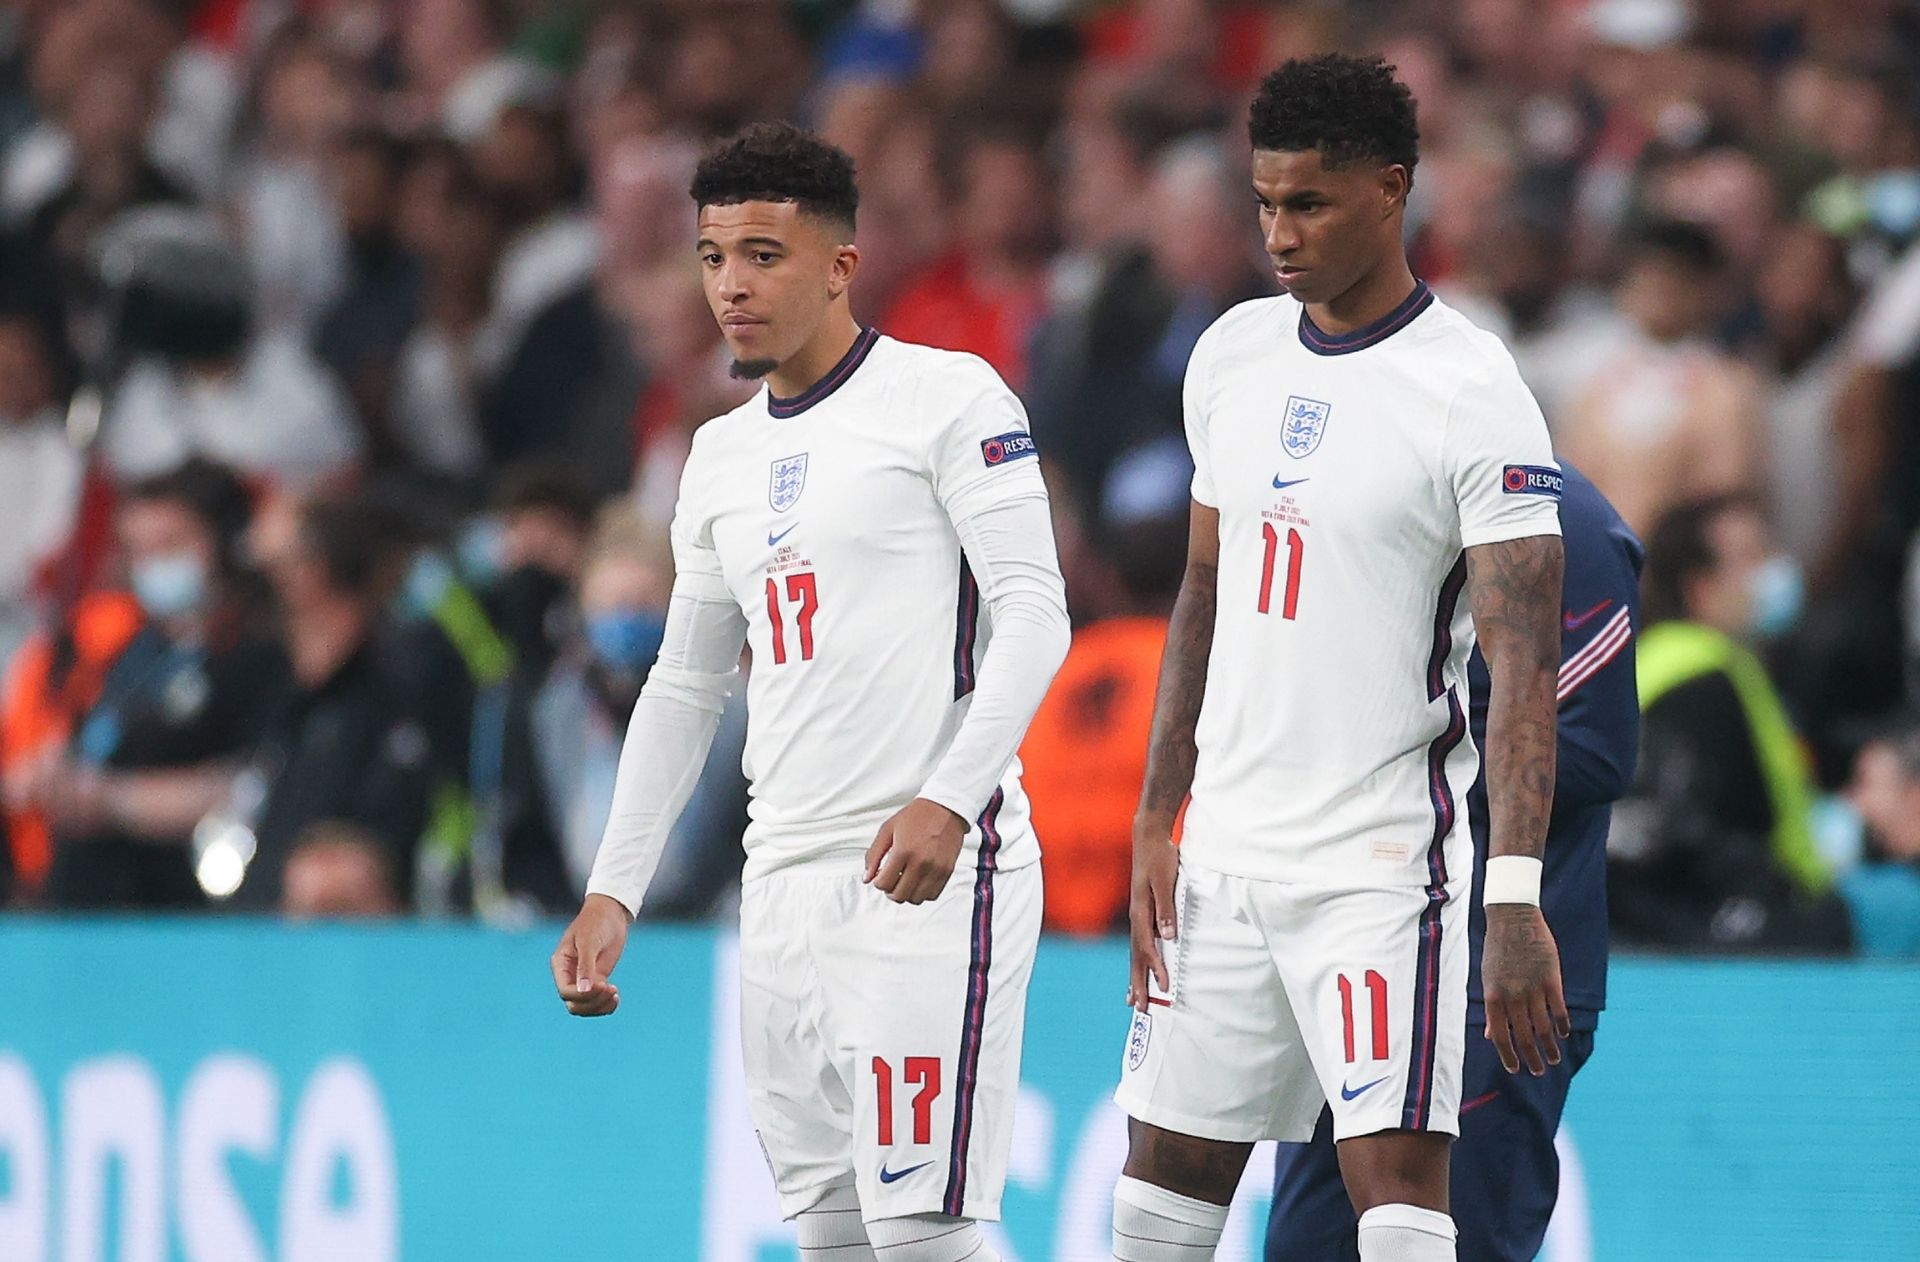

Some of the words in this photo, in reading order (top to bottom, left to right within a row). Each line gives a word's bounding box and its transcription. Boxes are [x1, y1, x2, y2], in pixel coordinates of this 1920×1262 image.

[1257, 521, 1303, 620] 11
[765, 572, 818, 664] 17
[1337, 969, 1389, 1063] 11
[871, 1056, 941, 1146] 17
